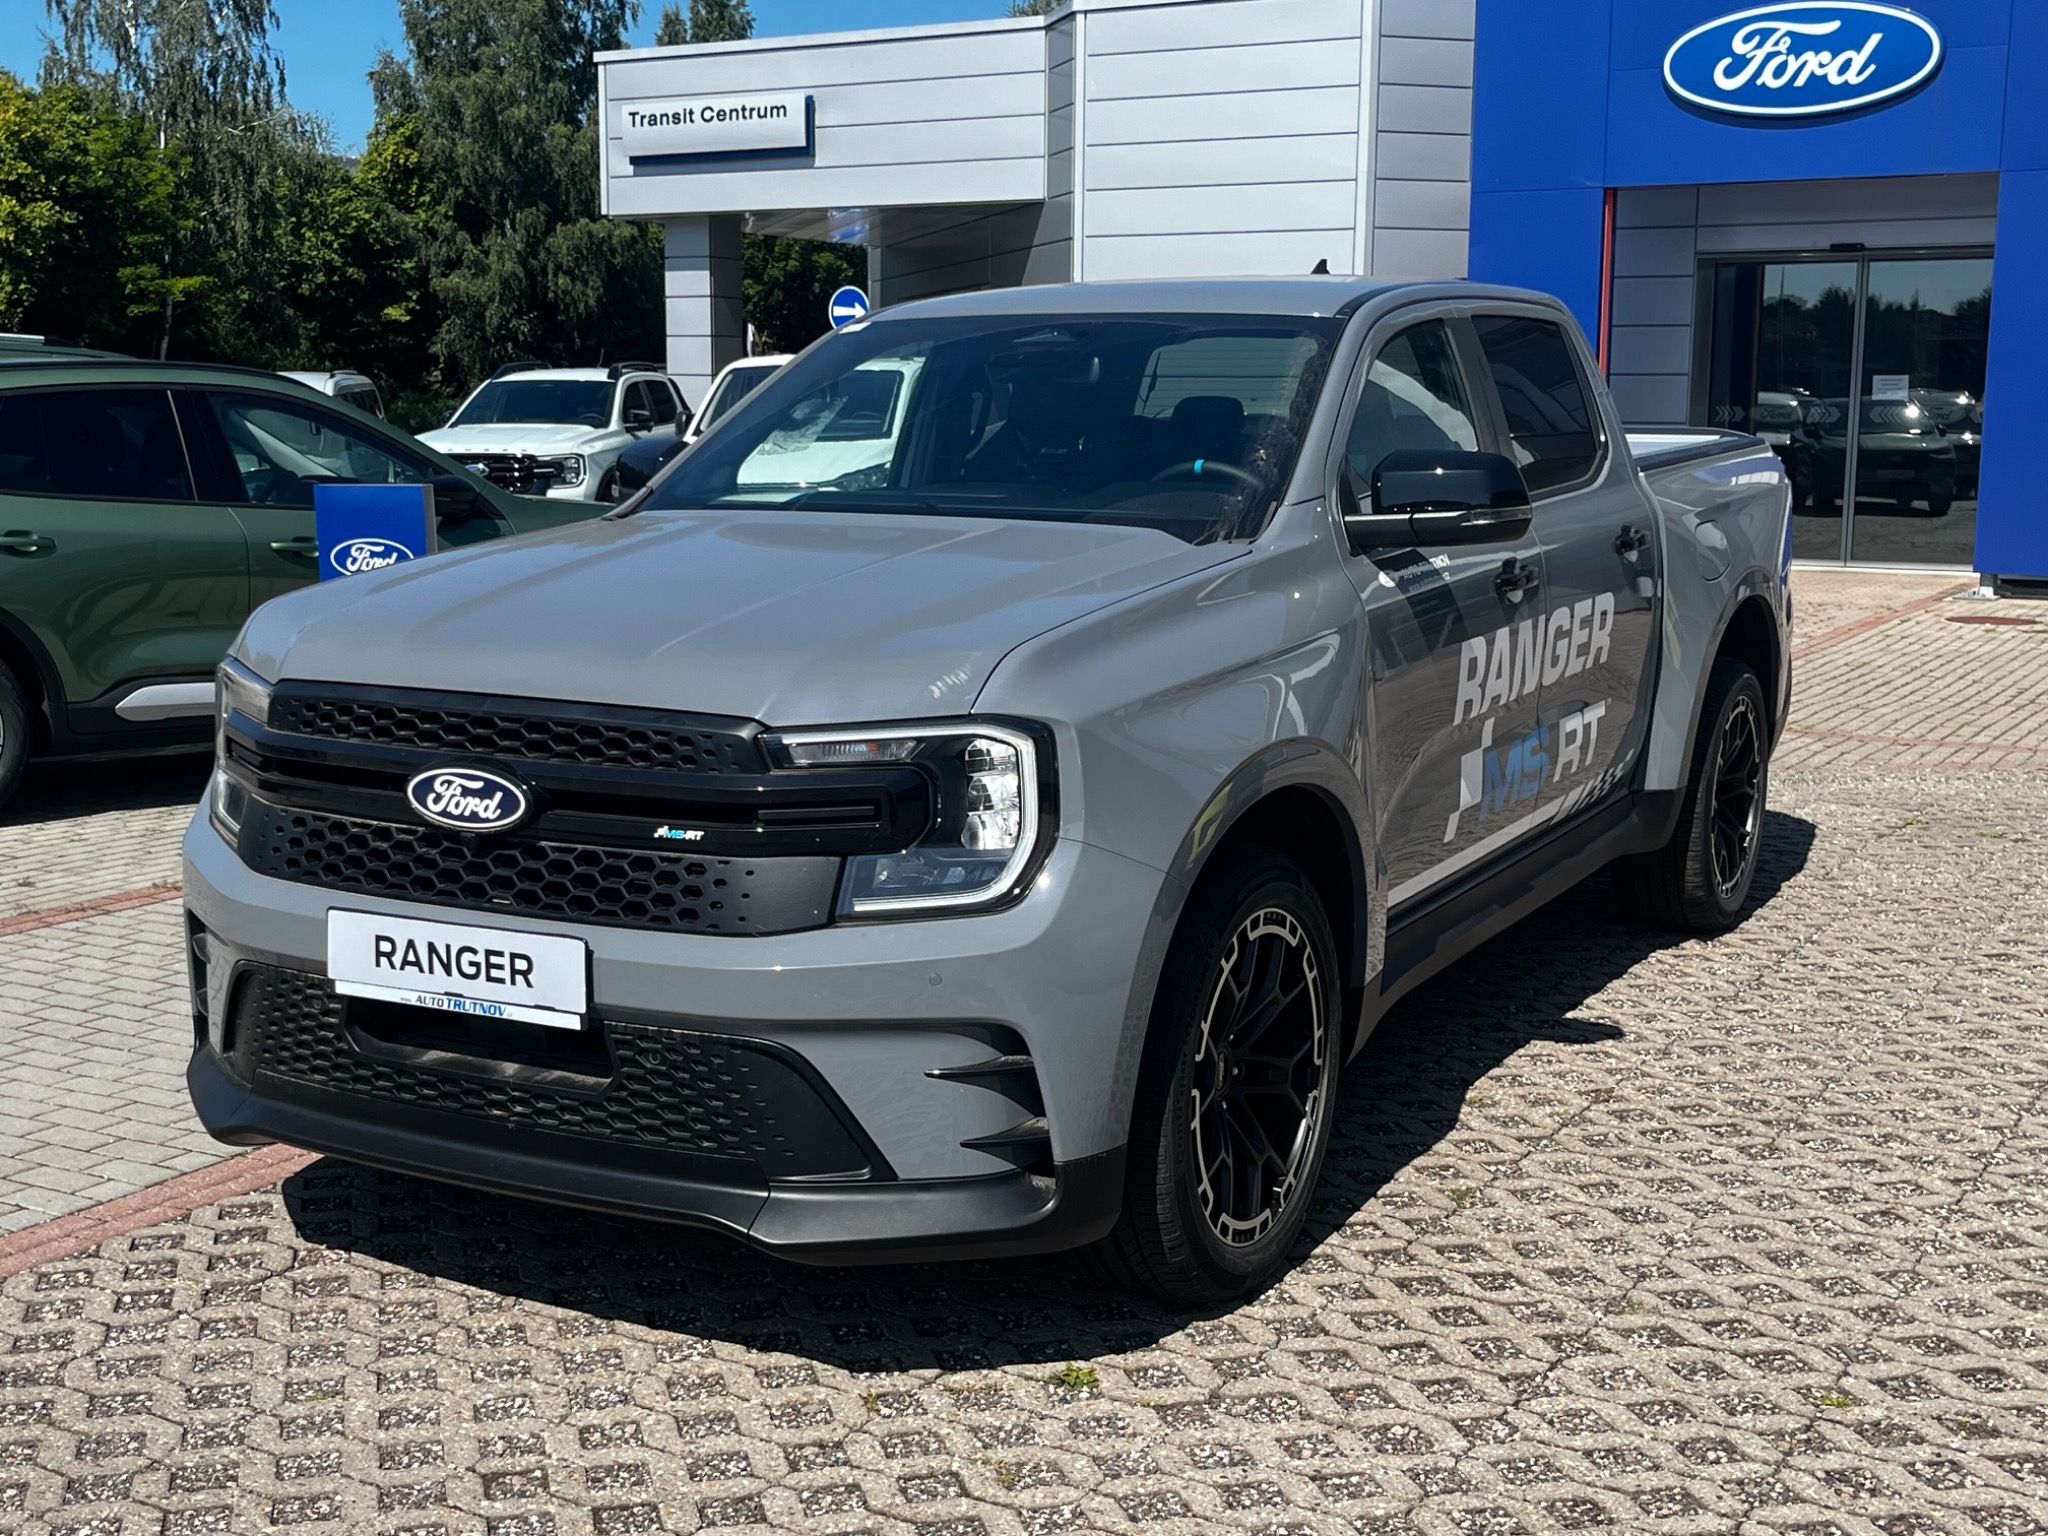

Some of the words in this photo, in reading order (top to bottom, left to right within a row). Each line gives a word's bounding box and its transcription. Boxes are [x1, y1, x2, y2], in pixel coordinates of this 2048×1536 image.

[1713, 20, 1883, 91] Ford
[628, 107, 695, 128] Transit
[700, 104, 787, 123] Centrum
[346, 544, 398, 572] Ford
[1453, 591, 1615, 726] RANGER
[426, 774, 504, 820] Ford
[374, 934, 535, 989] RANGER
